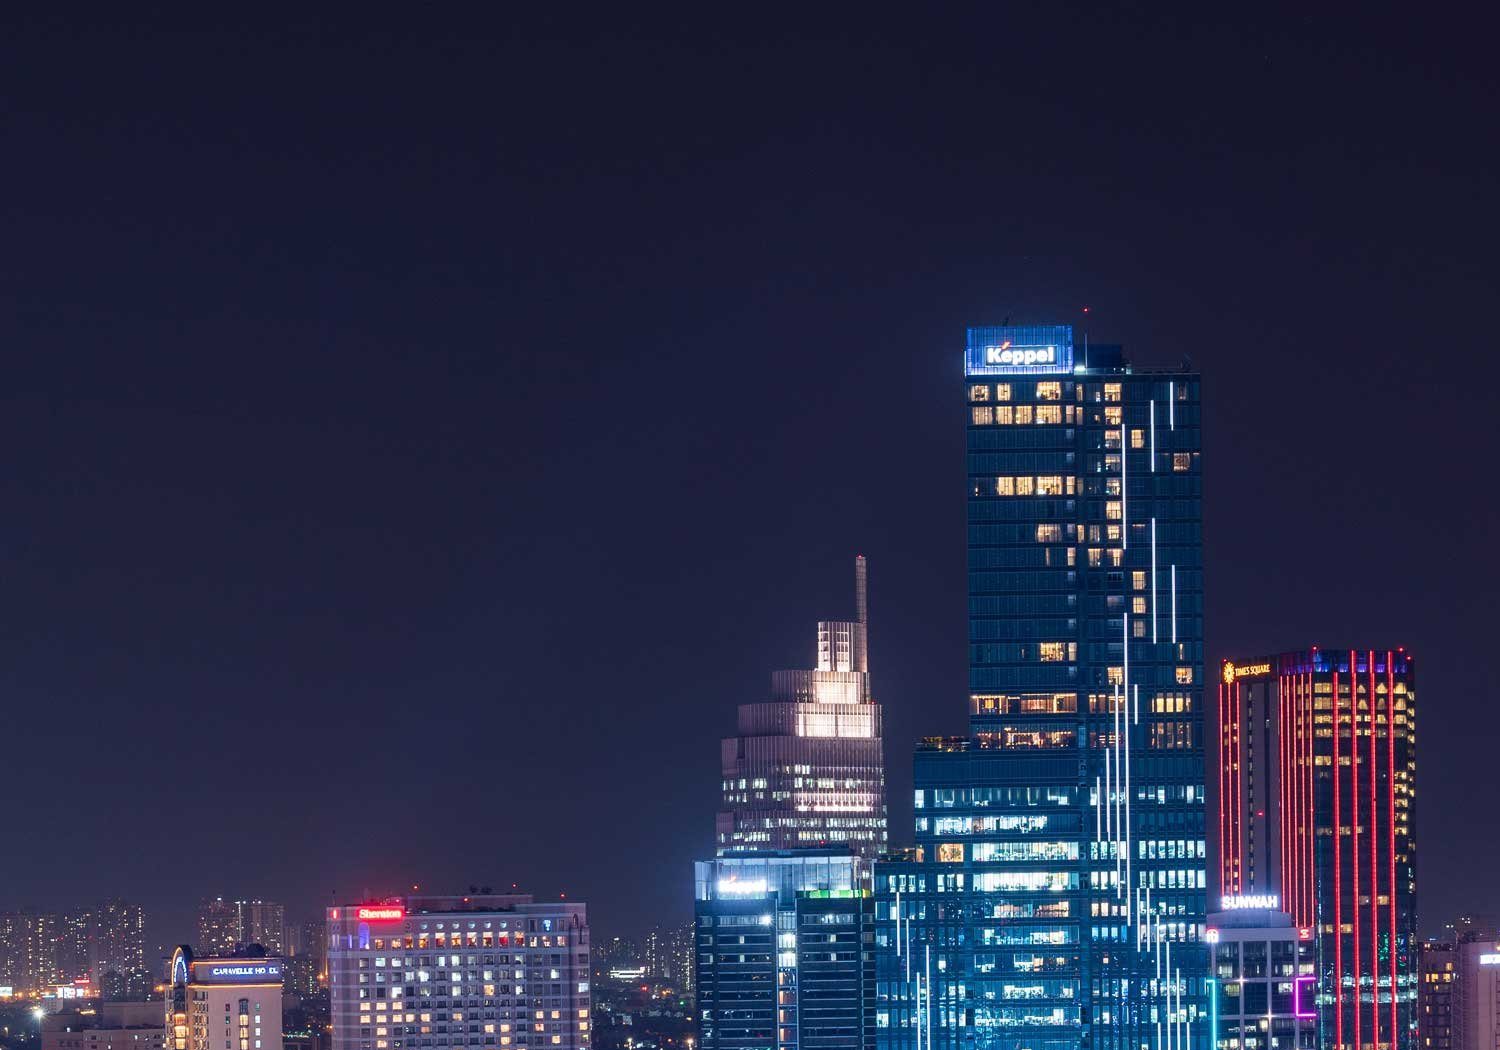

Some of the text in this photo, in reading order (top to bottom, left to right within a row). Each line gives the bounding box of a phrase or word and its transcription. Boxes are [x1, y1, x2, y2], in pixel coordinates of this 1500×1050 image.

[986, 346, 1054, 365] Keppel
[1235, 664, 1270, 676] TIMES SQUARE
[1221, 895, 1278, 910] SUNWAH
[359, 908, 402, 919] Sheraton
[213, 966, 279, 975] CARAVELLE HOEL
